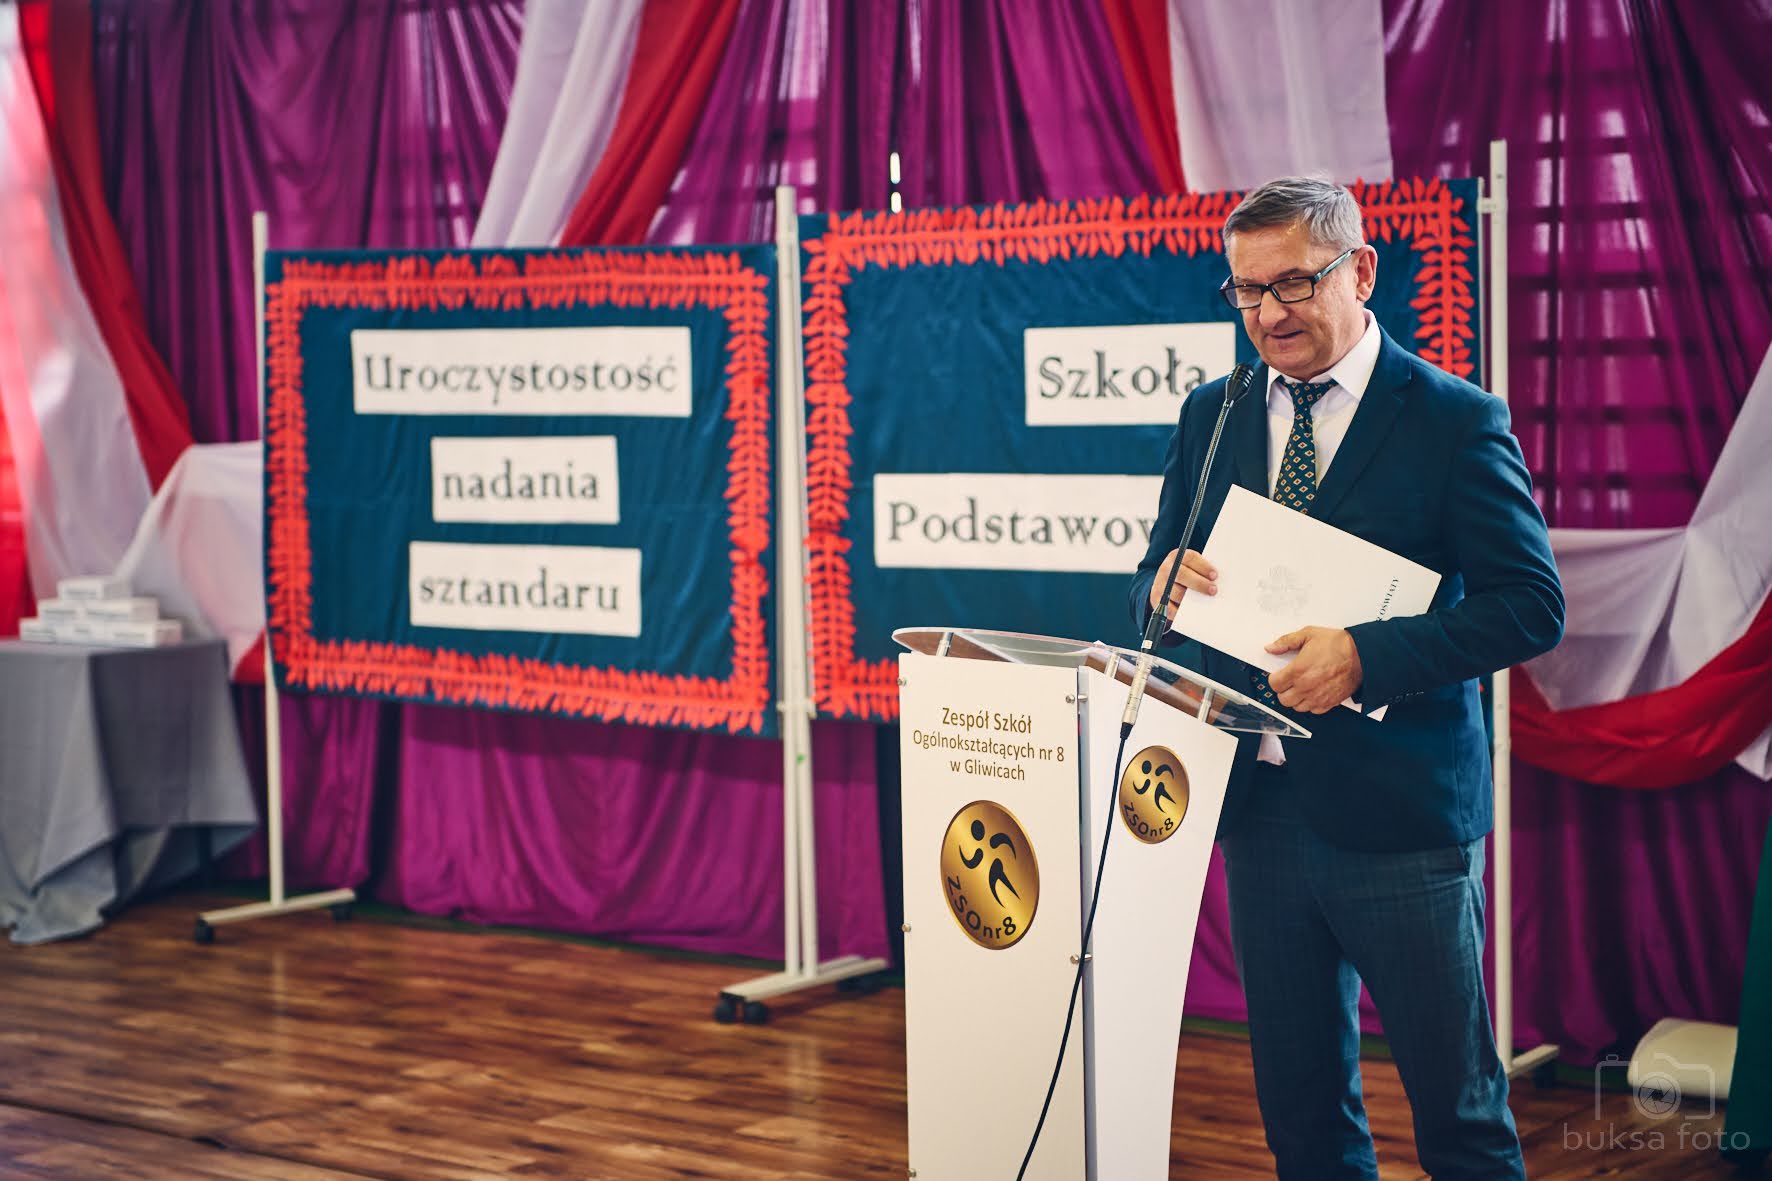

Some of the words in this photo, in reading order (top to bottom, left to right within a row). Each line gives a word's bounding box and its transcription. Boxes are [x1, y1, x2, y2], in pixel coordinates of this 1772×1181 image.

[364, 354, 678, 405] Uroczystostość
[1038, 347, 1207, 399] Szkoła
[443, 459, 599, 500] nadania
[419, 566, 620, 611] sztandaru
[942, 707, 989, 731] Zespół
[993, 713, 1032, 734] Szkół
[913, 729, 1035, 760] Ogólnokształcących
[1039, 747, 1053, 761] nr
[1056, 746, 1065, 762] 8
[950, 761, 961, 773] w
[964, 759, 1025, 781] Gliwicach
